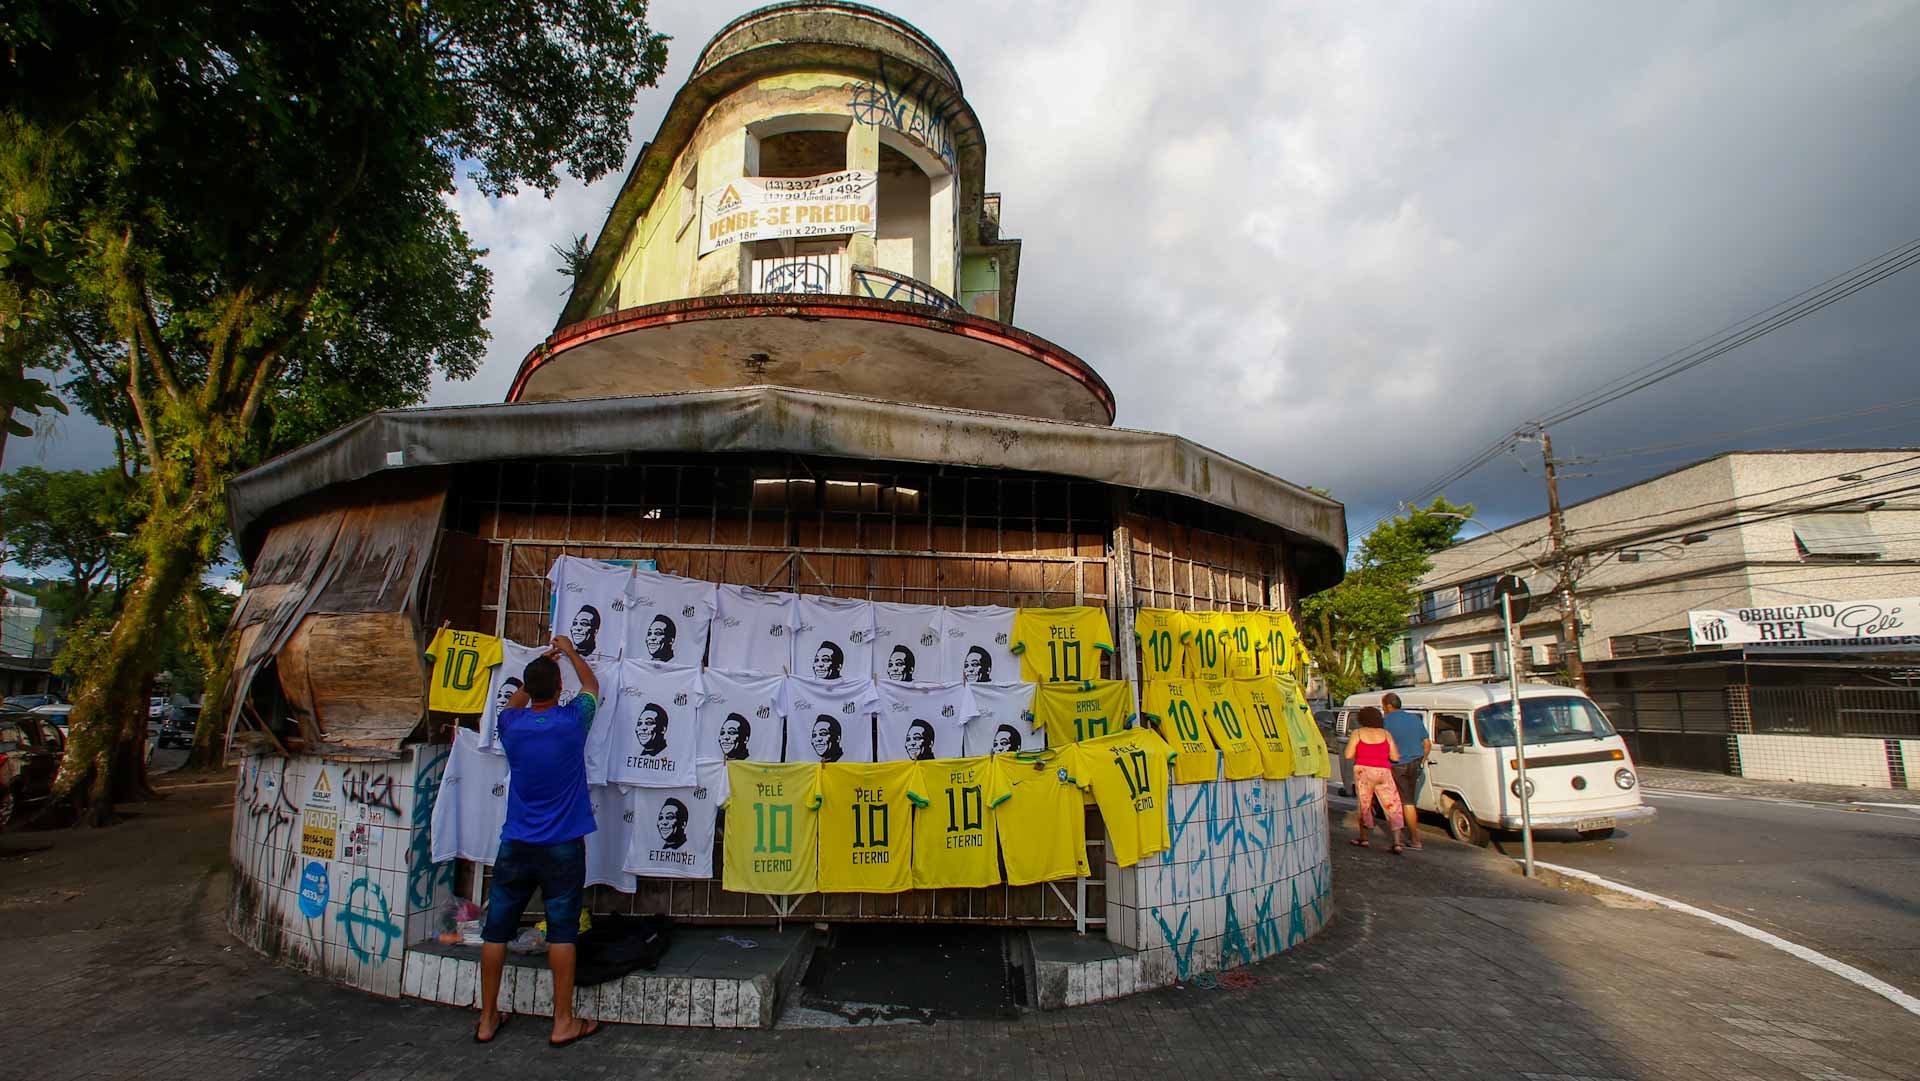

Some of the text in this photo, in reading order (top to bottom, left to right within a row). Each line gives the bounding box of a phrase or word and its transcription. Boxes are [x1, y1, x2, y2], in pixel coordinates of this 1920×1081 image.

[709, 206, 789, 240] VENDE-SE
[805, 226, 827, 235] 22m
[839, 224, 855, 233] 5m
[1738, 604, 1835, 622] OBRIGADO
[1757, 620, 1807, 640] REI
[1149, 629, 1172, 672] 10
[1195, 628, 1217, 668] 10
[1233, 626, 1249, 652] 10
[1268, 629, 1285, 666] 10
[442, 647, 479, 691] 10
[1048, 640, 1081, 682] 10
[1076, 700, 1102, 713] BRASIL
[1168, 699, 1199, 741] 10
[1214, 700, 1242, 740] 10
[1253, 704, 1279, 739] 10
[1074, 716, 1107, 741] 10
[627, 756, 676, 772] ETERNO REI
[1114, 750, 1150, 800] 10
[303, 811, 337, 830] VENDE
[852, 803, 889, 848] 10
[945, 785, 983, 833] 10
[753, 802, 793, 854] 10
[946, 833, 983, 849] ETERNO
[649, 850, 696, 865] ETERNO REI
[754, 859, 792, 873] ETERNO
[852, 851, 890, 865] ETERNO
